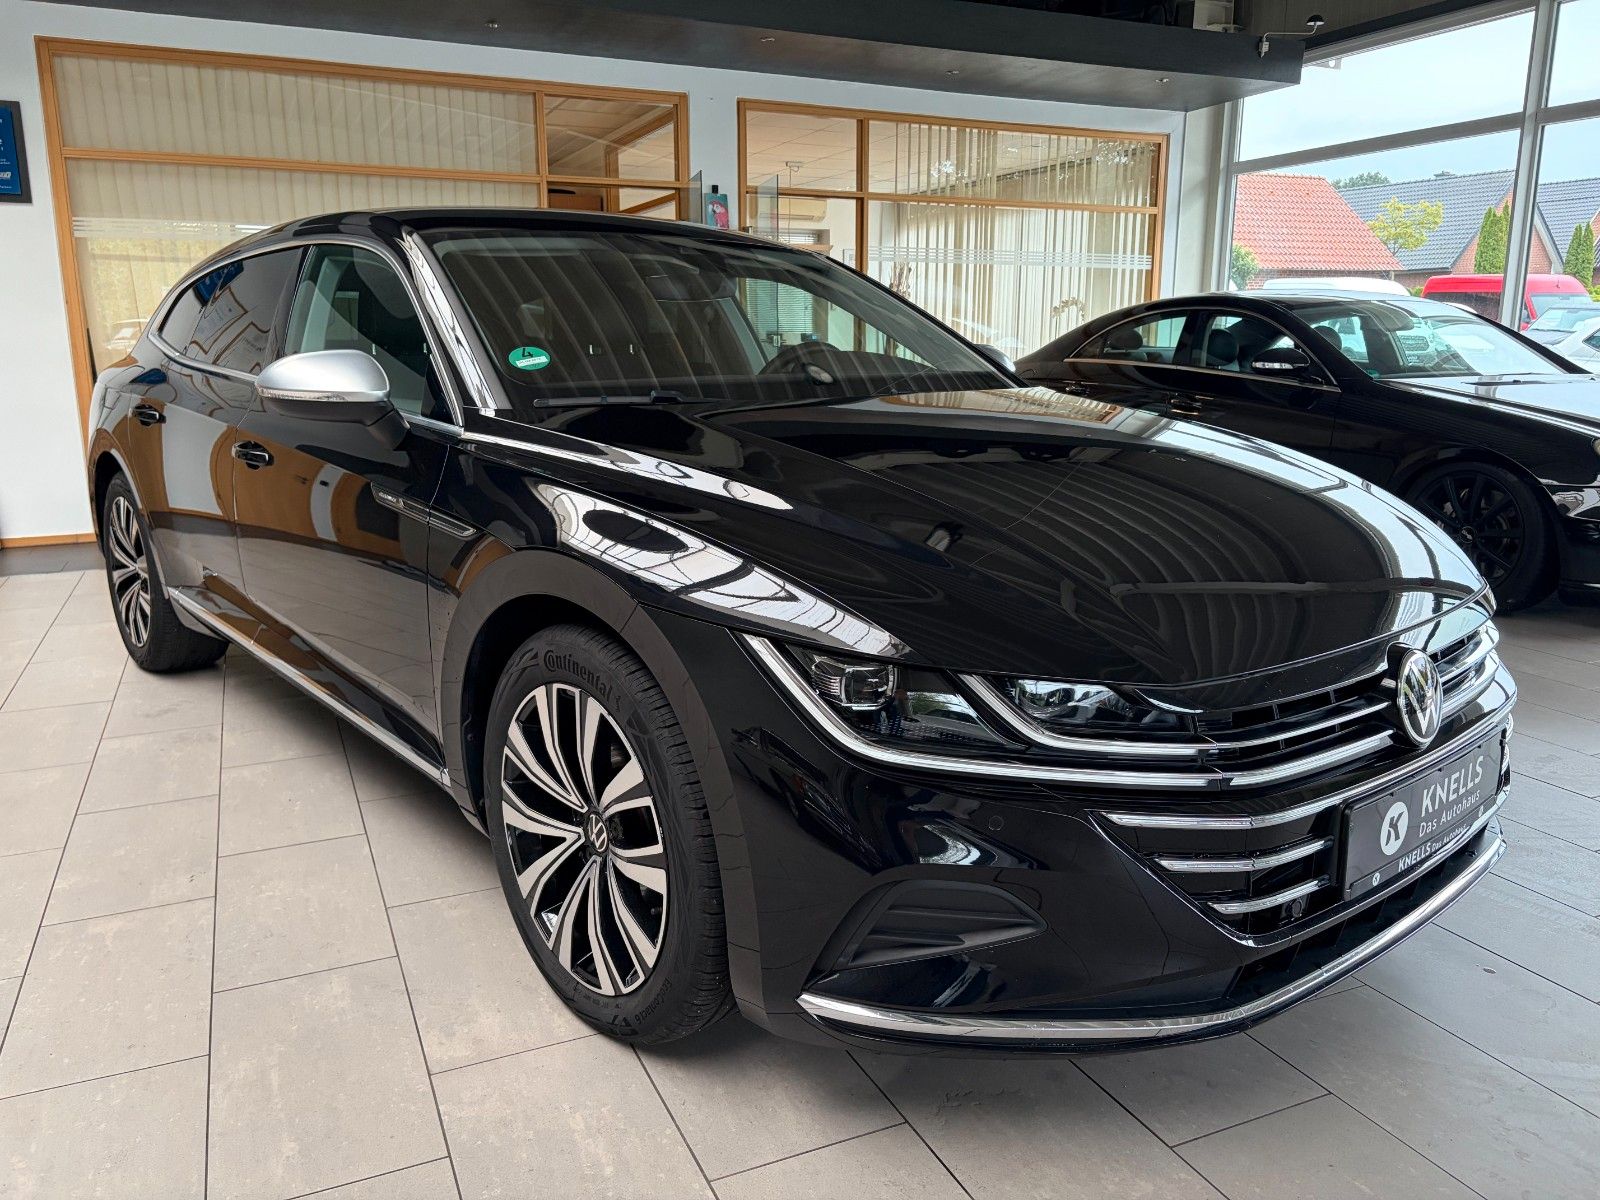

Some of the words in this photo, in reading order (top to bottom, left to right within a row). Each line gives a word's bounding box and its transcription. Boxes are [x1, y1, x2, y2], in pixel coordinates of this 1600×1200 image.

[543, 649, 613, 702] Continental
[1421, 755, 1484, 818] KNELLS
[1419, 818, 1437, 838] Das
[1440, 789, 1481, 825] Autohaus
[1398, 842, 1431, 872] KNELLS
